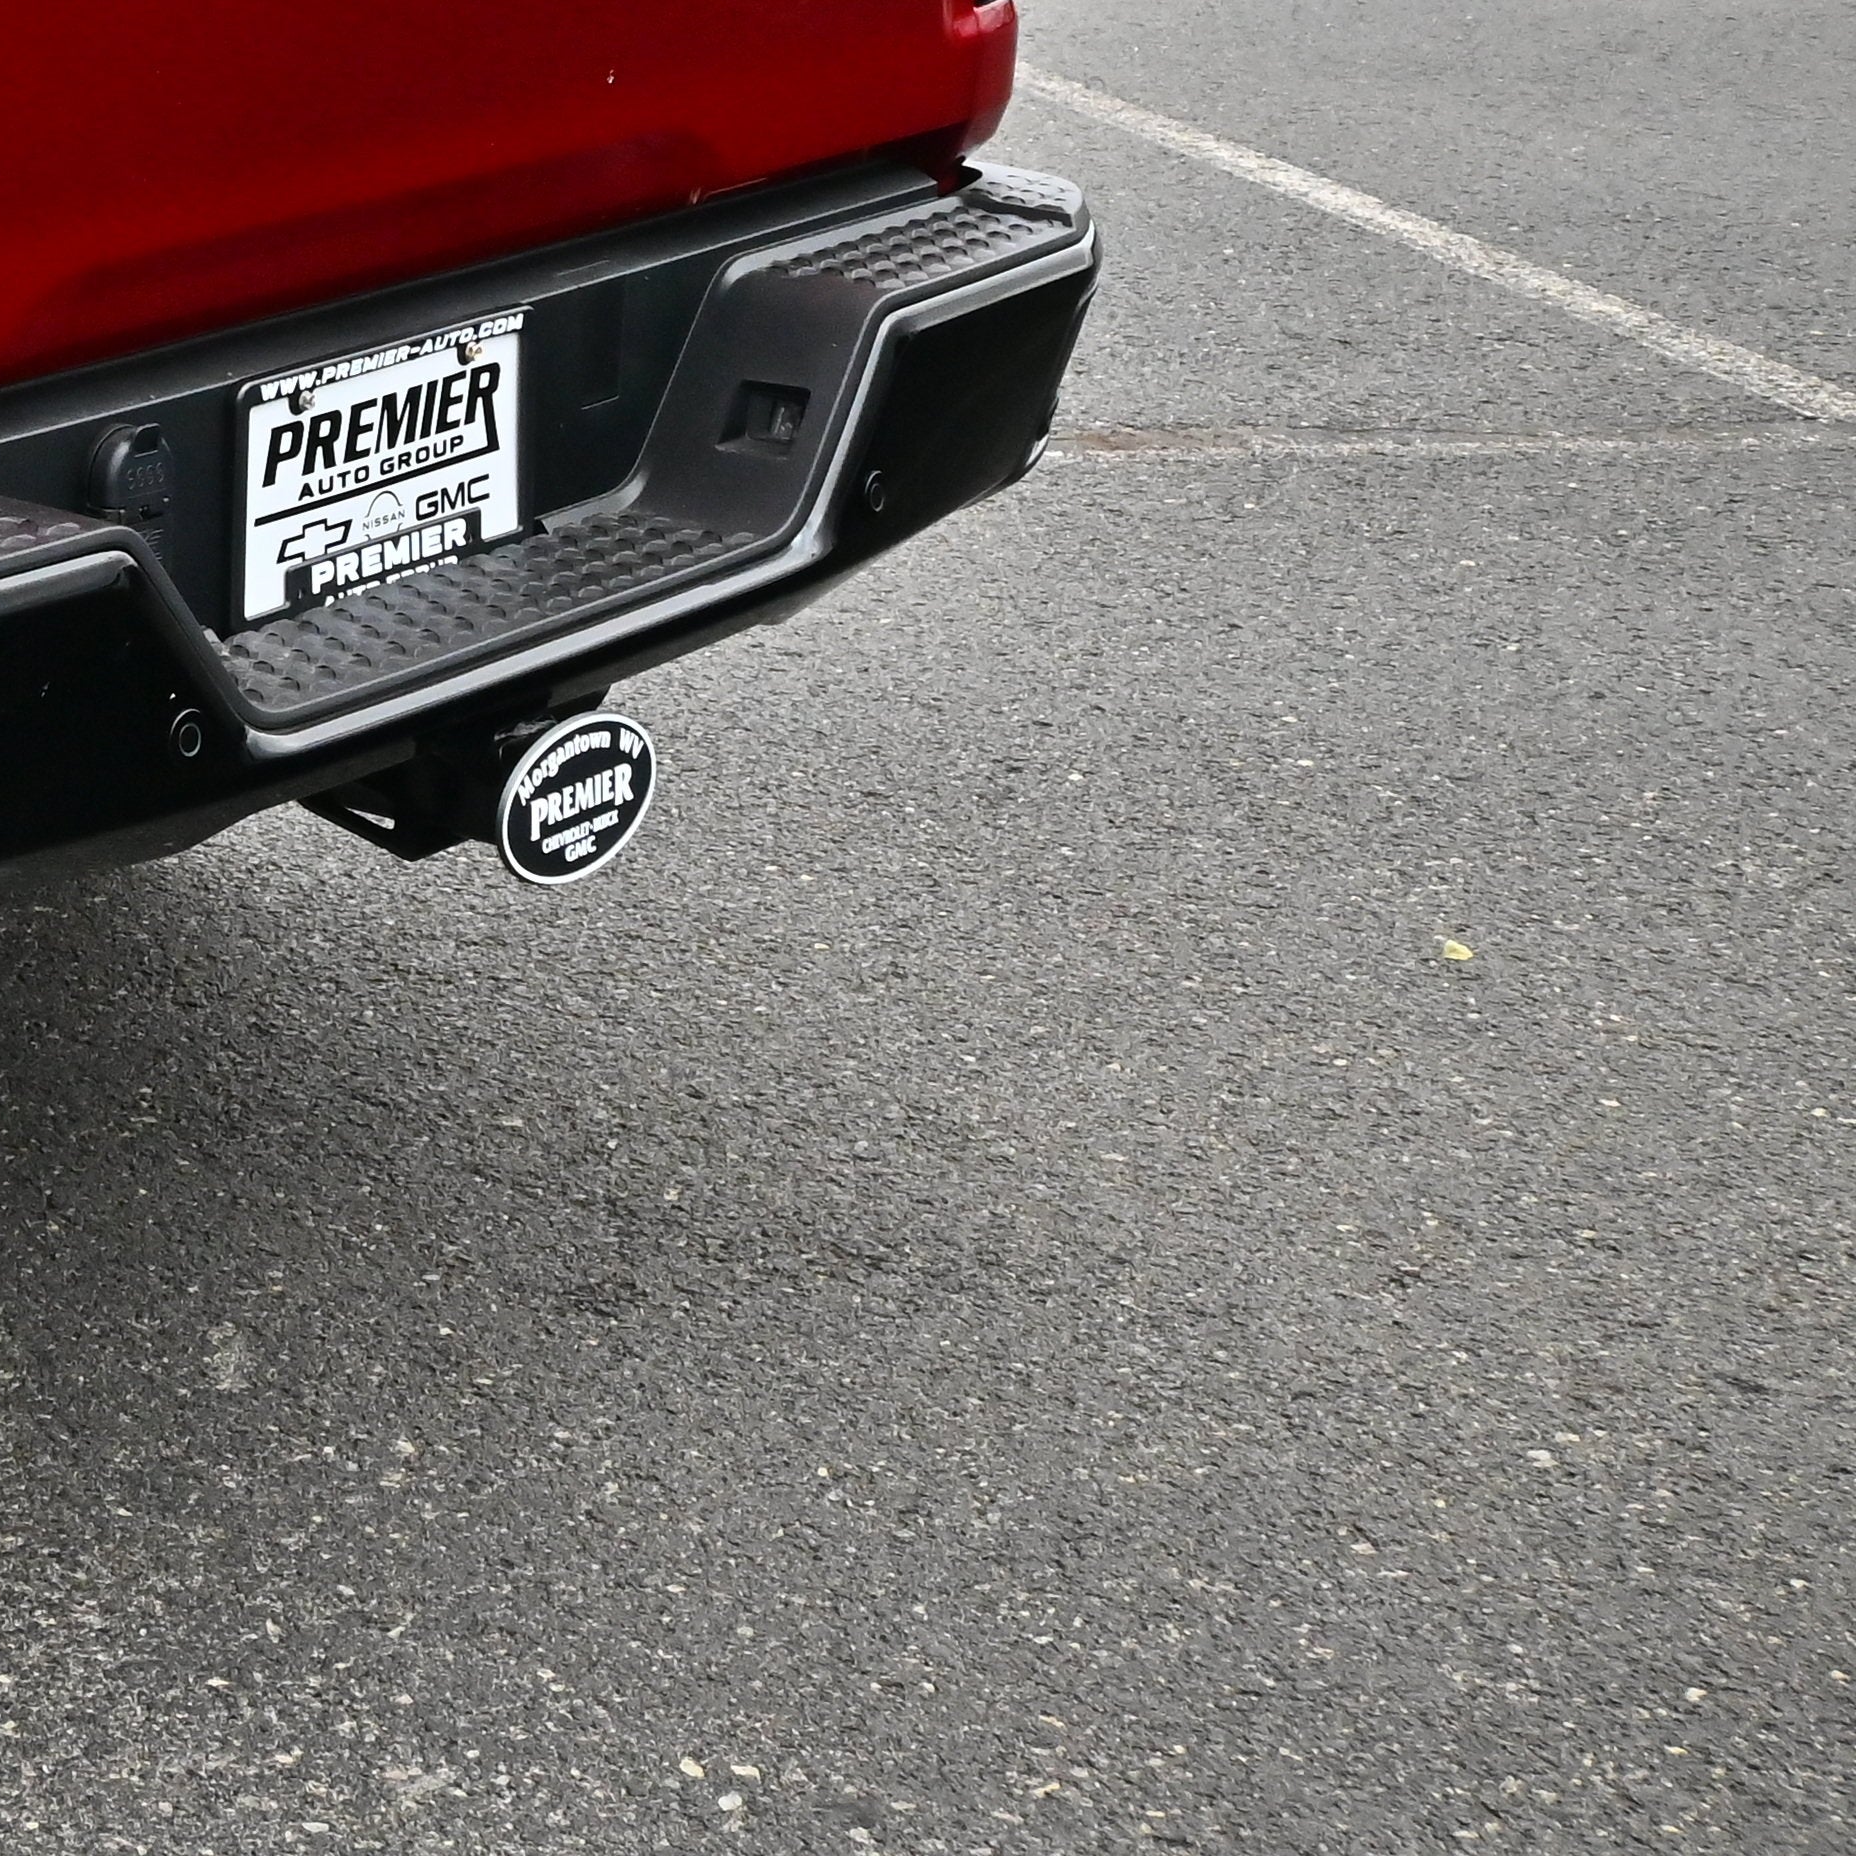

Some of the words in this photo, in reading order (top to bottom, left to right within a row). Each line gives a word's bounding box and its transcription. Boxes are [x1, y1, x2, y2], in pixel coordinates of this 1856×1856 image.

[259, 312, 525, 402] WWW.PREMIER-AUTO.COM
[261, 361, 501, 488] PREMIER
[297, 465, 370, 502] AUTO
[379, 434, 465, 475] GROUP
[361, 509, 407, 531] NISSAN
[415, 473, 491, 521] GMC
[310, 517, 468, 596] PREMIER
[517, 730, 611, 807] Morgantown
[618, 727, 645, 760] WV
[529, 762, 635, 842] PREMIER
[564, 835, 597, 863] GMC
